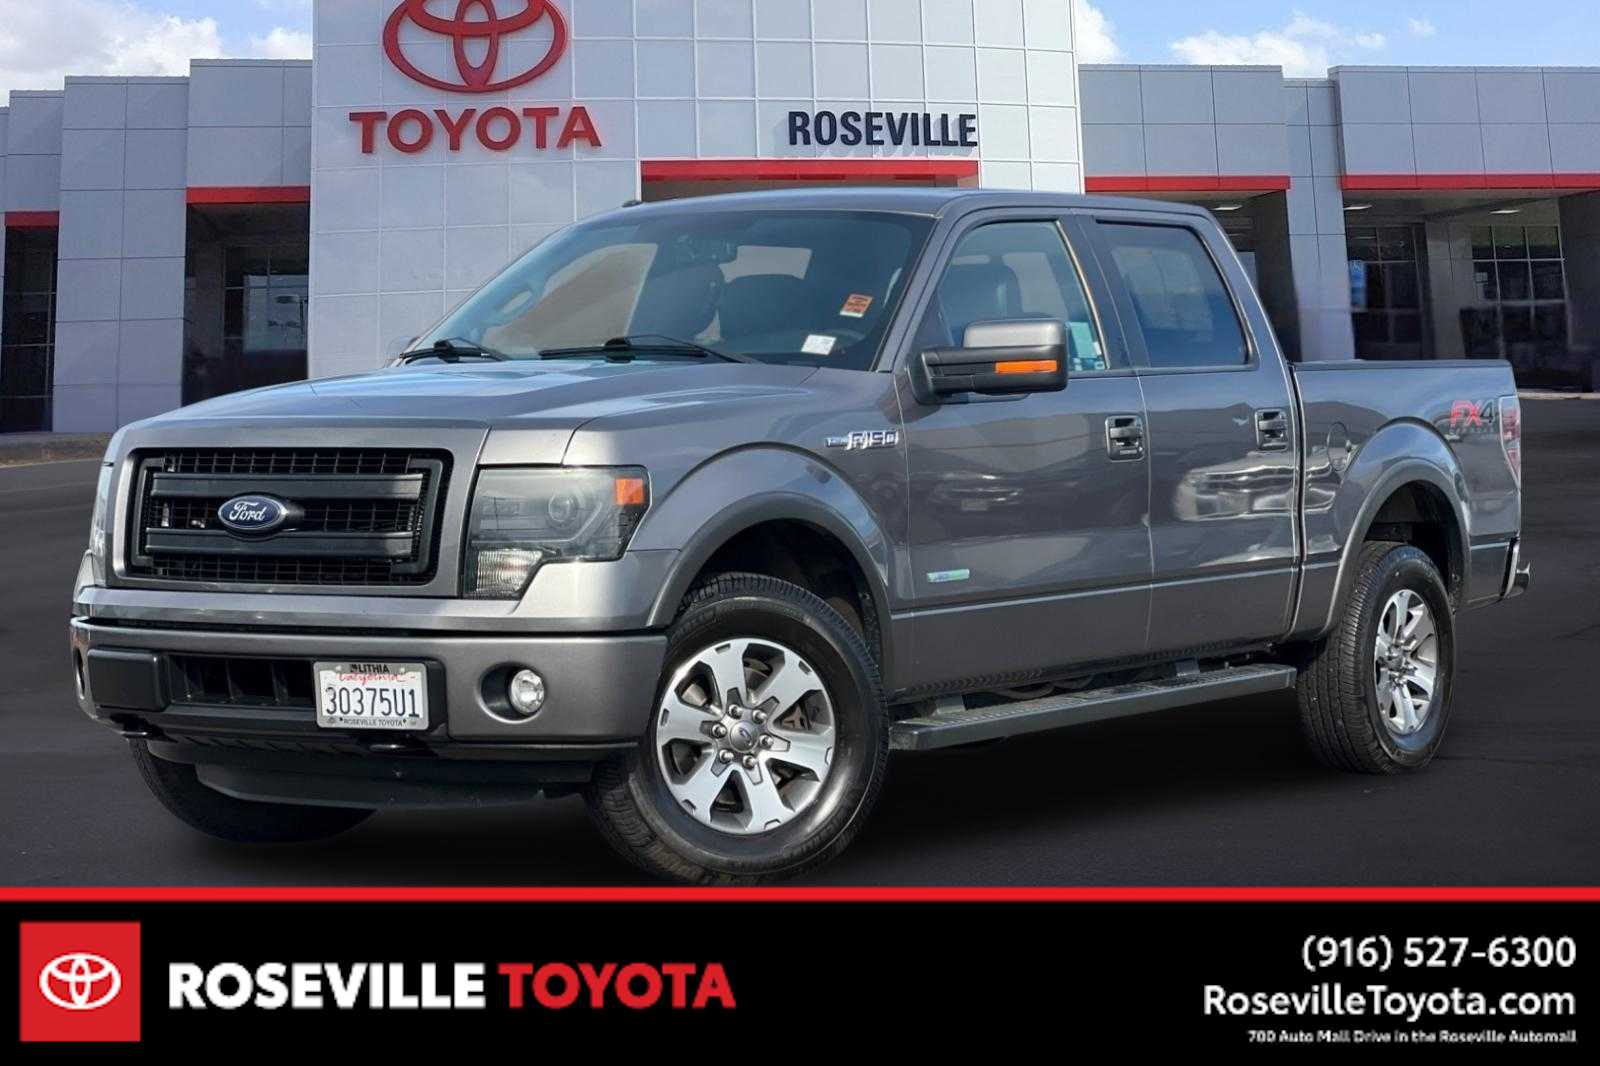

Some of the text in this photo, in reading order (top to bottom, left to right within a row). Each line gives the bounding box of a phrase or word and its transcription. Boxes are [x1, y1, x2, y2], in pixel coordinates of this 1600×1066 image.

[349, 106, 602, 154] TOYOTA
[788, 110, 978, 147] ROSEVILLE
[1450, 400, 1495, 428] FX4
[229, 501, 267, 520] Ford
[358, 664, 390, 673] LITHIA
[325, 686, 419, 718] 30375U1
[379, 719, 403, 727] TOYOTA
